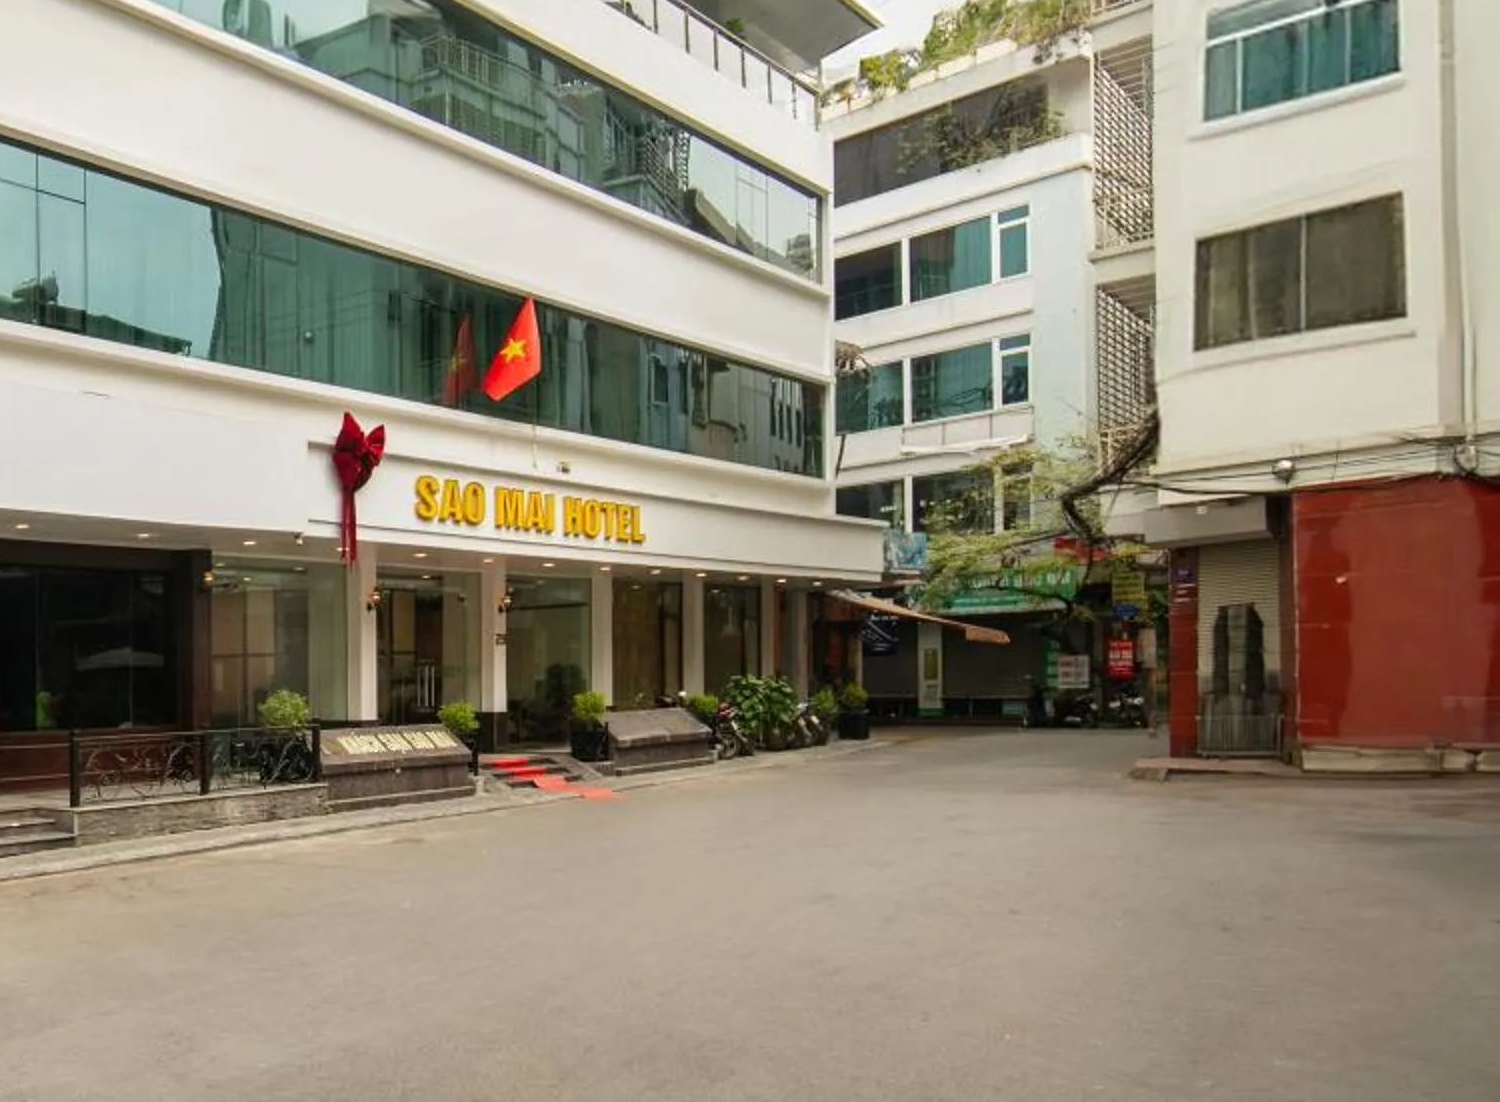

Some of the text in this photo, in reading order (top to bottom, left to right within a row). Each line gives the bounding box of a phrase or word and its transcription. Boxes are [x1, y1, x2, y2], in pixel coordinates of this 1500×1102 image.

[414, 474, 646, 544] SAO MAI HOTEL
